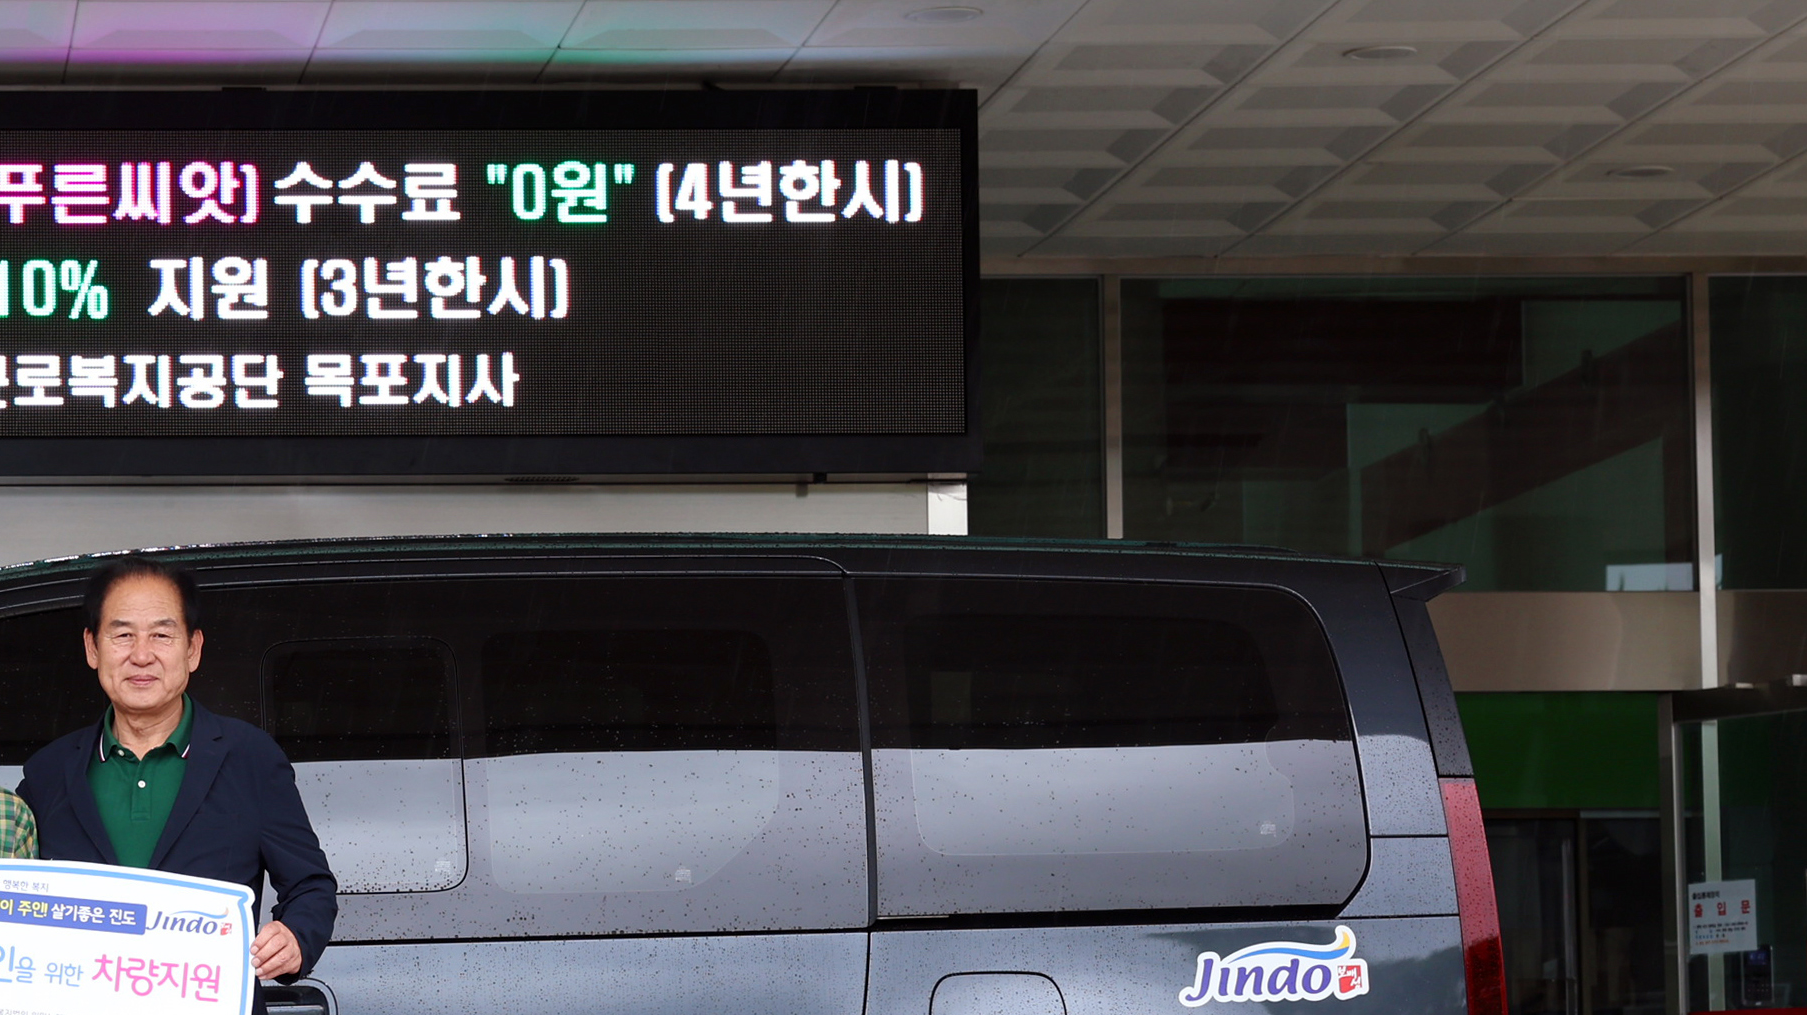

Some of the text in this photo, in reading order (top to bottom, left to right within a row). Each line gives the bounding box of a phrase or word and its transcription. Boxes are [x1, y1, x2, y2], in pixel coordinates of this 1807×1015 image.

[273, 161, 461, 225] 수수료
[486, 160, 634, 224] "0원"
[147, 256, 269, 322] 지원
[304, 351, 520, 408] 목포지사
[2, 878, 29, 891] 행복한
[31, 881, 49, 893] 복지
[17, 898, 49, 918] 주인!
[50, 903, 106, 925] 살기좋은
[108, 907, 137, 926] 진도
[145, 910, 219, 936] Jindo
[43, 962, 84, 988] 위한
[92, 951, 222, 1004] 차량지원
[1184, 958, 1332, 1002] Jindo
